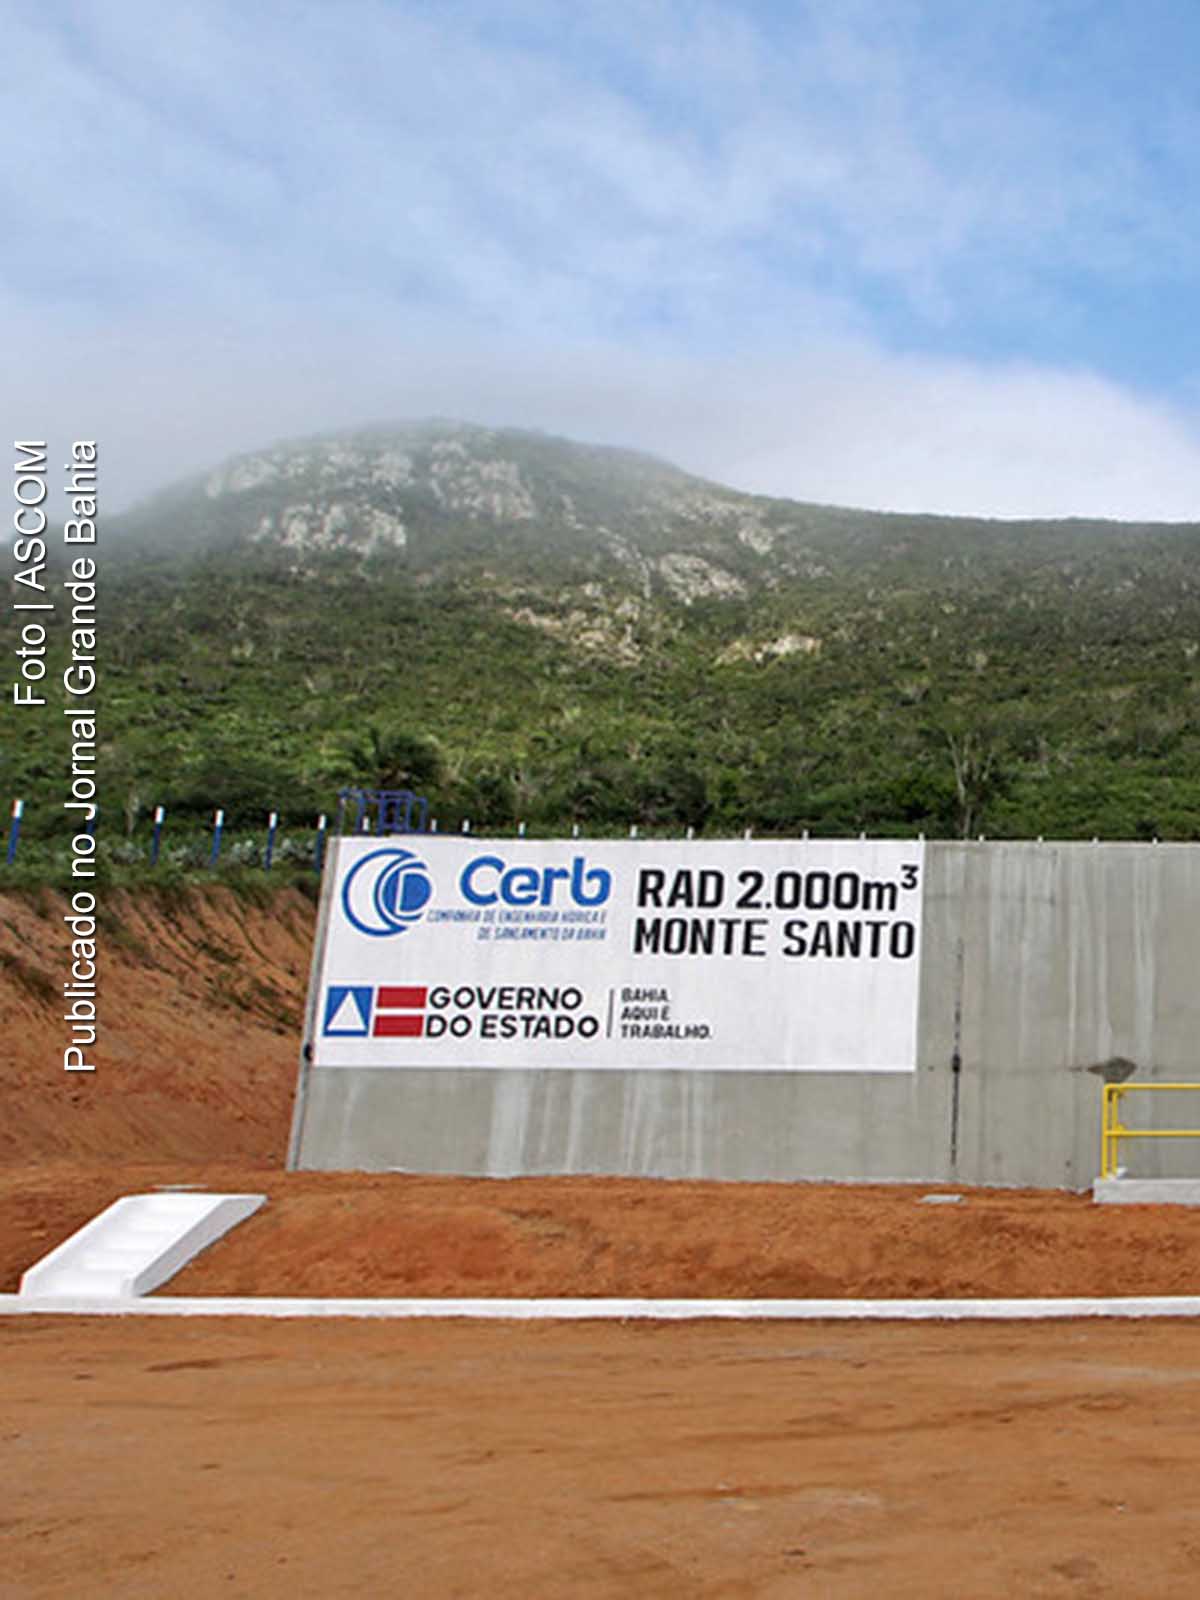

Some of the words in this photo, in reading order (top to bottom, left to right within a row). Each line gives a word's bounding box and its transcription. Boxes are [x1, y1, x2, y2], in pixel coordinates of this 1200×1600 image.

[459, 855, 612, 907] Cerb
[636, 868, 725, 909] RAD
[632, 917, 769, 957] MONTE
[782, 920, 916, 959] SANTO
[428, 986, 583, 1011] GOVERNO
[621, 1005, 659, 1021] AQUI
[424, 1014, 473, 1038] DO
[480, 1014, 600, 1040] ESTADO
